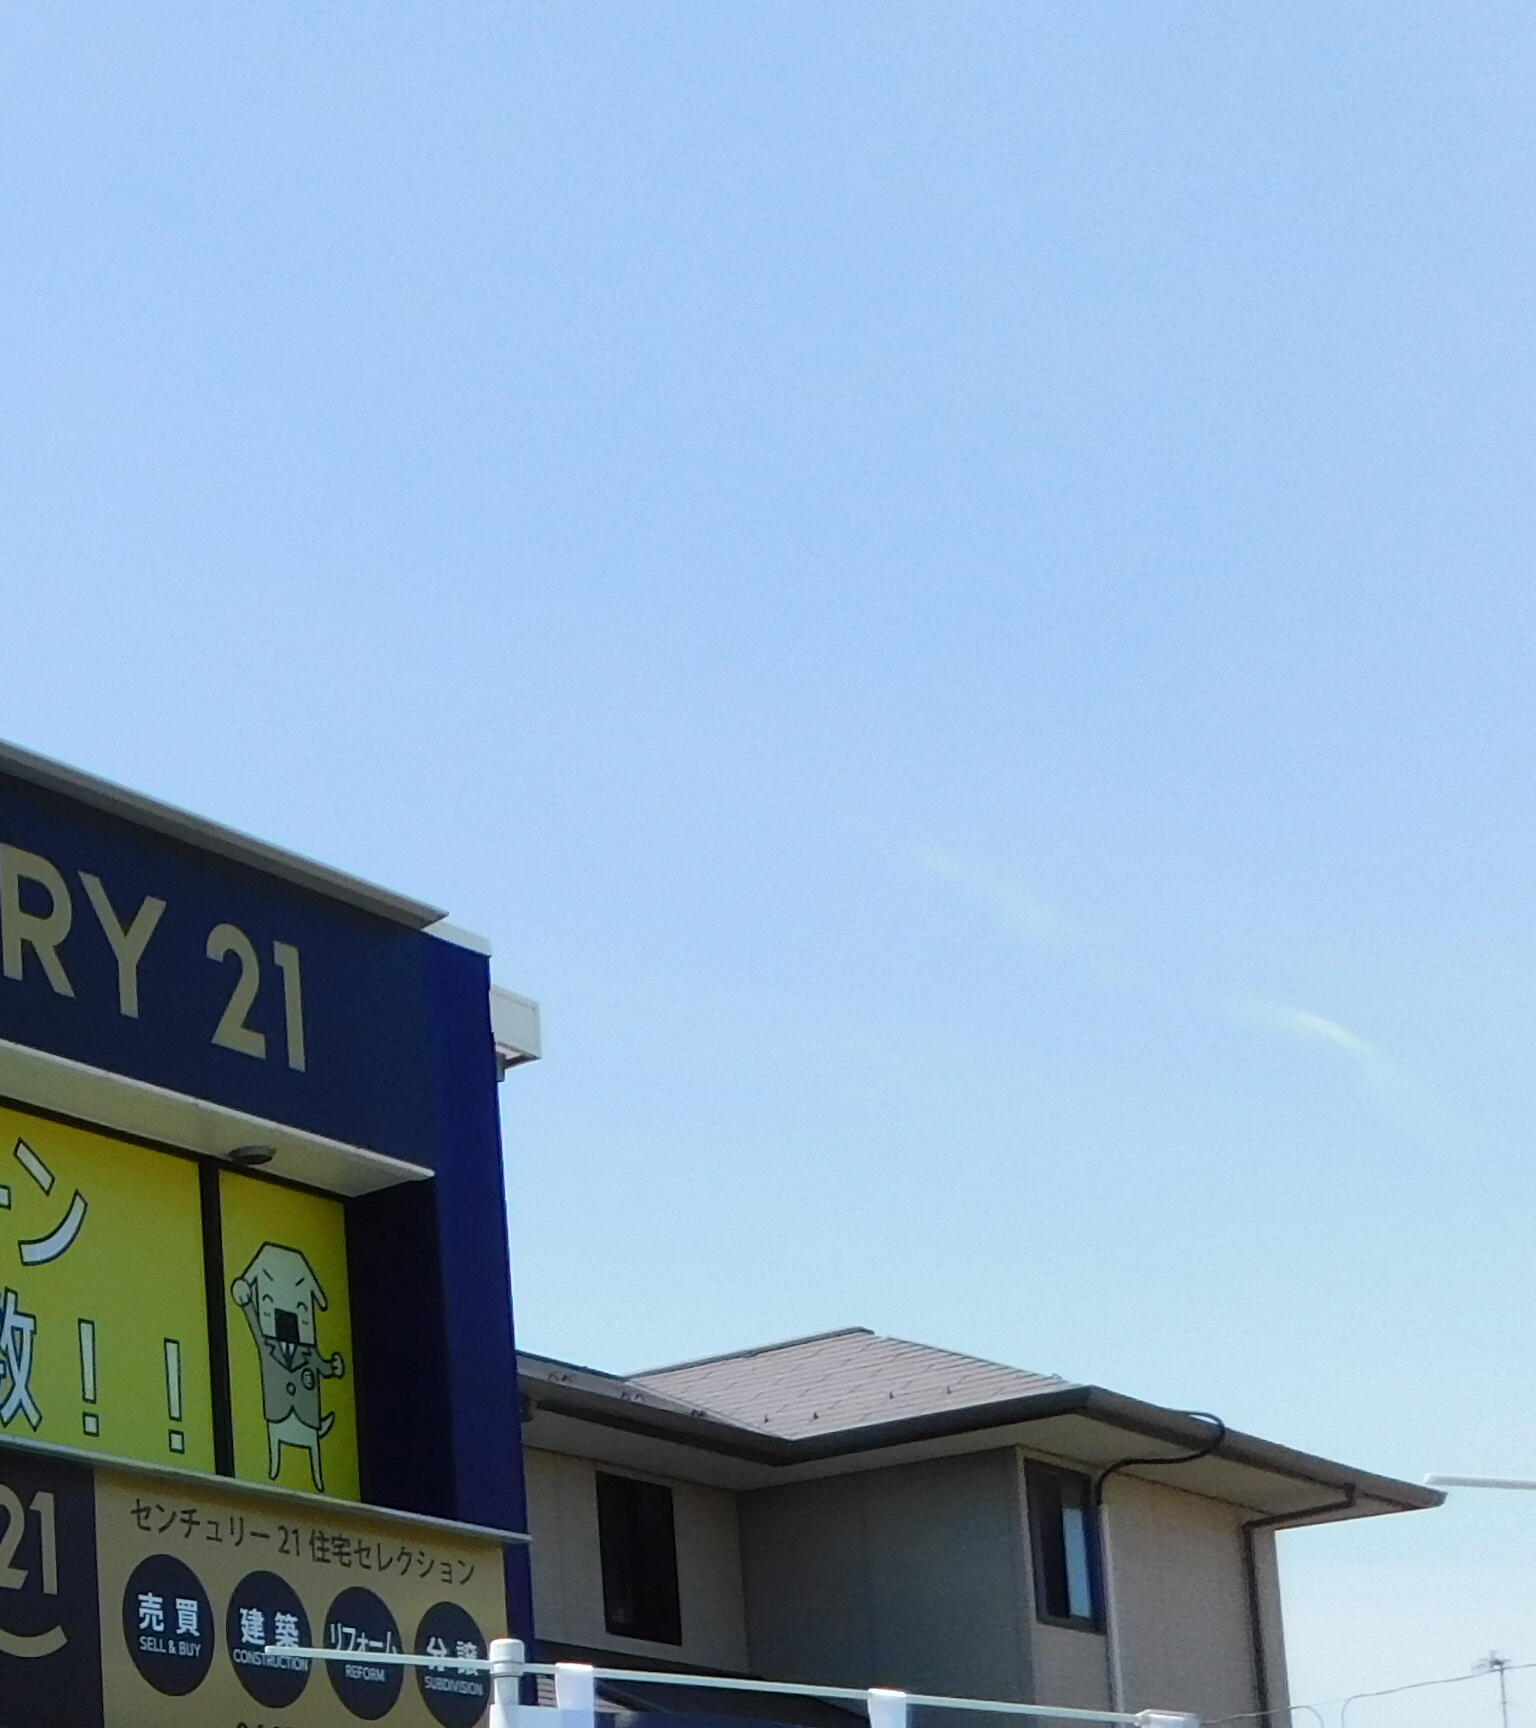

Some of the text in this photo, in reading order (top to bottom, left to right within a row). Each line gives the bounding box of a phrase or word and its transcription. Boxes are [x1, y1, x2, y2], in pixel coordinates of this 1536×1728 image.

[205, 922, 310, 1073] 21
[137, 1591, 201, 1638] 売買
[239, 1606, 301, 1650] 建築
[139, 1634, 202, 1659] SELL & BUY
[232, 1648, 311, 1673] CONSTRUCTION
[344, 1664, 386, 1683] REFORM
[423, 1676, 484, 1697] SUBDIVISION
